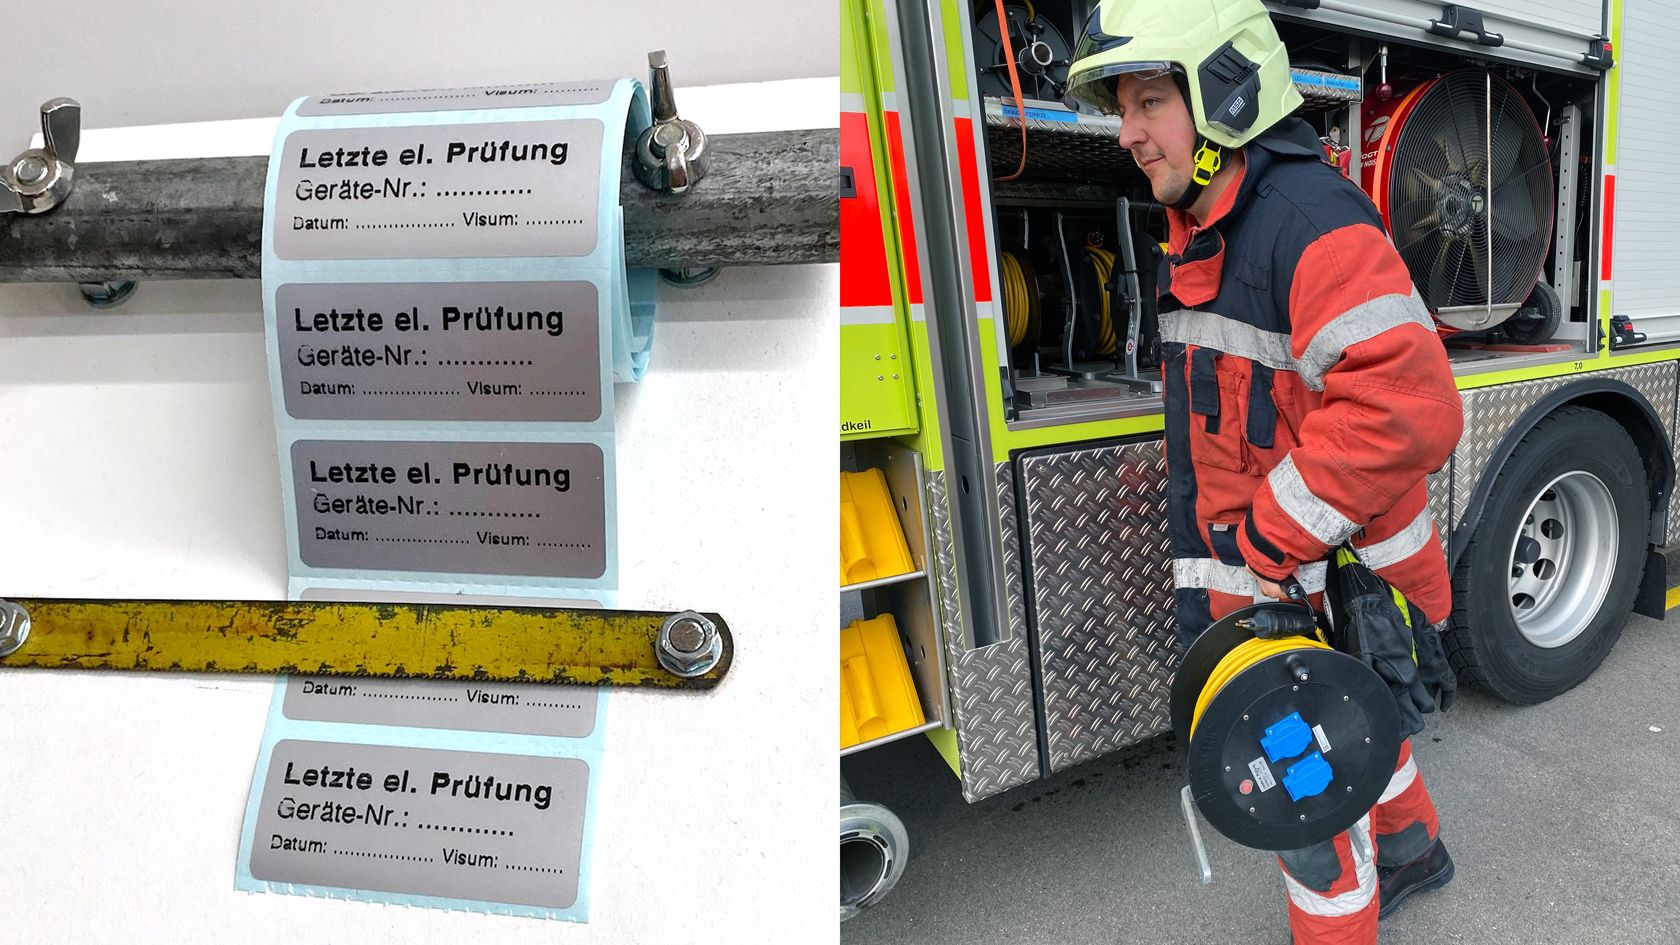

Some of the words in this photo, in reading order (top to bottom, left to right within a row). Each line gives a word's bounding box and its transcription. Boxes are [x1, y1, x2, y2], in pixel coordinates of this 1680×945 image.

[319, 96, 375, 104] Datum:
[485, 88, 539, 97] Visum:
[1229, 96, 1244, 115] MSA
[300, 147, 388, 168] Letzte
[399, 143, 433, 165] el.
[446, 140, 569, 166] Prüfung
[295, 177, 426, 201] Geräte-Nr.:
[292, 216, 349, 230] Datum:
[463, 212, 518, 227] Visum:
[295, 308, 384, 332] Letzte
[395, 307, 429, 331] el.
[442, 306, 564, 336] Prüfung
[297, 344, 427, 367] Geräte-Nr.:
[300, 381, 355, 395] Datum:
[467, 381, 522, 395] Visum:
[840, 419, 871, 432] dkeil
[310, 461, 396, 485] Letzte
[407, 462, 441, 485] el.
[453, 462, 571, 492] Prüfung
[313, 493, 439, 516] Geräte-Nr.:
[315, 527, 369, 541] Datum:
[477, 531, 530, 546] Visum:
[303, 681, 356, 697] Datum:
[466, 690, 520, 706] Visum:
[284, 762, 372, 790] Letzte
[383, 770, 417, 794] el.
[430, 772, 552, 810] Prüfung
[277, 797, 408, 828] Geräte-Nr.:
[271, 834, 327, 854] Datum:
[443, 848, 498, 868] Visum:
